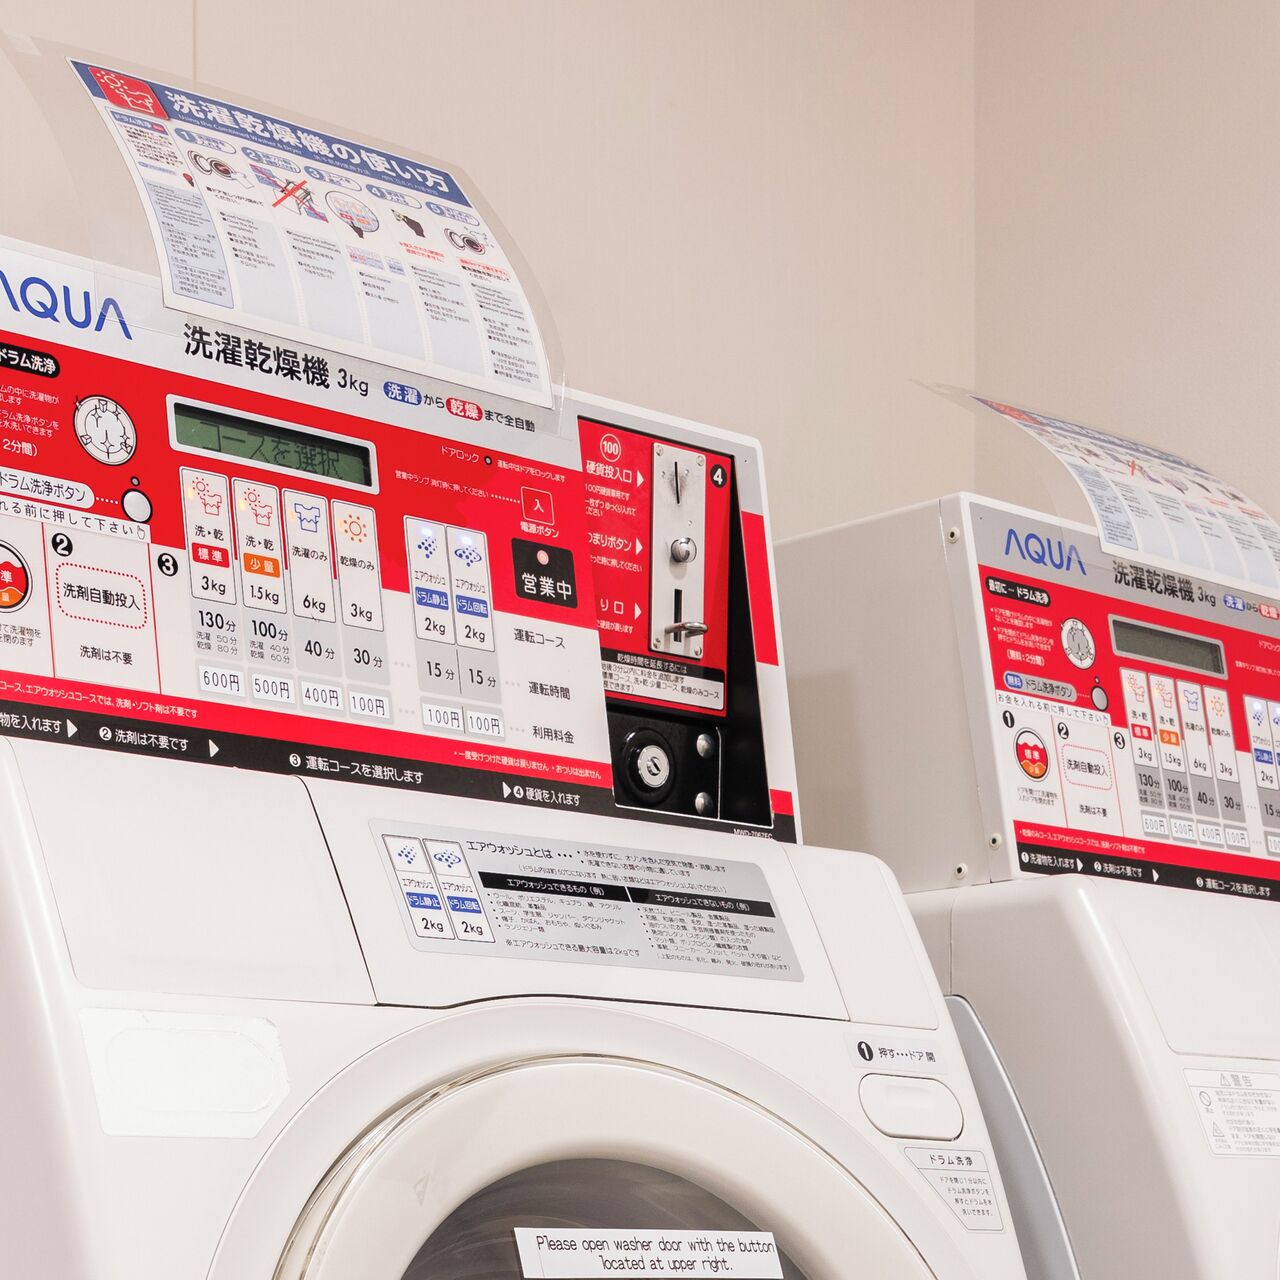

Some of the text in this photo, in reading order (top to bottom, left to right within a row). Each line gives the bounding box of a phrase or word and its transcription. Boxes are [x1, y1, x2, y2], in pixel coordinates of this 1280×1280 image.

[165, 90, 450, 192] 洗濯乾燥機の使い方
[183, 323, 369, 396] 洗濯乾燥機 3kg
[441, 446, 479, 463] ドアロック
[586, 460, 632, 483] 硬貨投入口
[0, 472, 86, 502] ドラム洗浄ボタン
[534, 500, 544, 513] 入
[520, 521, 559, 538] 電源ボタン
[197, 548, 223, 563] 標準
[292, 545, 328, 562] 洗濯のみ
[1004, 528, 1087, 576] AQUA
[249, 557, 275, 574] 少量
[340, 555, 375, 572] 乾燥のみ
[201, 576, 226, 595] 3kg
[521, 573, 573, 601] 営業中
[1113, 560, 1216, 607] 洗濯乾燥機 3kg
[62, 582, 141, 611] 洗剤自動投入
[250, 585, 279, 605] 1.5kg
[303, 595, 326, 613] 6kg
[416, 589, 488, 615] ドラム静止 ドラム回転
[350, 603, 373, 622] 3kg
[424, 617, 485, 643] 2kg 2kg
[513, 627, 566, 649] 運転コース
[79, 645, 133, 665] 洗剤は不要
[203, 671, 240, 693] 600円
[254, 679, 290, 700] 500円
[528, 681, 571, 700] 運転時間
[304, 687, 339, 708] 400円
[351, 695, 385, 716] 100円
[427, 707, 501, 735] 100円 100円
[115, 728, 189, 752] 洗剤は不要です
[532, 725, 575, 744] 利用料金
[1138, 747, 1153, 761] 3kg
[305, 753, 424, 785] 運転コースを選択します
[1066, 759, 1108, 777] 洗剤自動投入
[1193, 758, 1207, 772] 6kg
[1220, 763, 1233, 776] 3kg
[1260, 770, 1274, 785] 2kg
[525, 787, 581, 806] 硬貨を入れます
[1079, 804, 1107, 817] 洗剤は不要
[1144, 814, 1164, 831] 600円
[1173, 821, 1194, 837] 500円
[1200, 826, 1221, 843] 400円
[1226, 831, 1246, 847] 100円
[406, 893, 481, 912] ドラム静止 ドラム回転
[421, 917, 484, 936] 2kg 2kg
[929, 1154, 973, 1166] ドラム洗浄
[536, 1235, 775, 1253] Please open washer door with the button
[599, 1255, 733, 1273] located at upper right.
